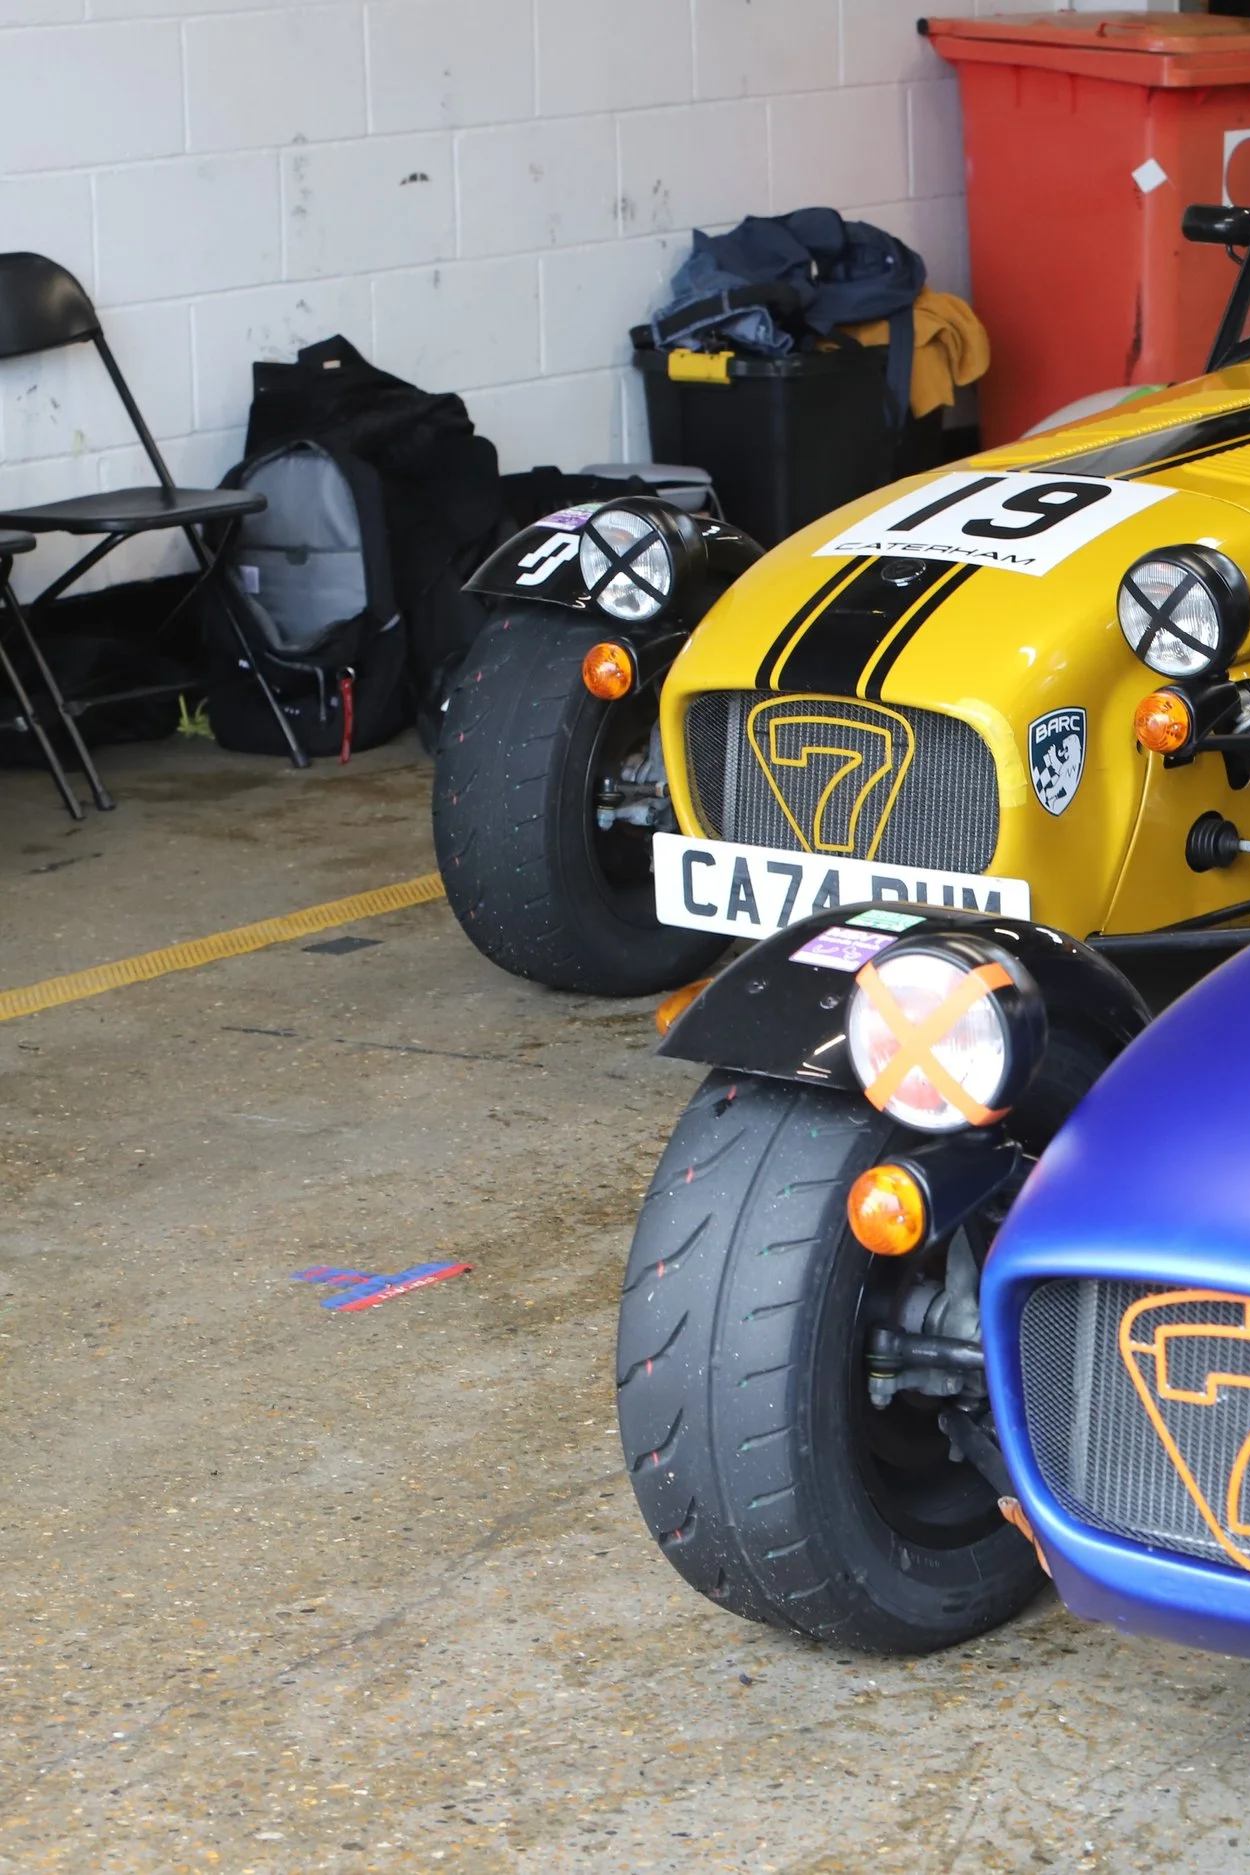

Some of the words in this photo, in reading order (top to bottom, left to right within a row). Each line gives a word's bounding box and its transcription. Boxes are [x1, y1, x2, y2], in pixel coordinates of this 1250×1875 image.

[886, 476, 1113, 540] 19
[834, 542, 1037, 566] CATERHAM
[1035, 715, 1081, 744] BARC
[769, 715, 893, 853] 7
[681, 849, 840, 928] CA74
